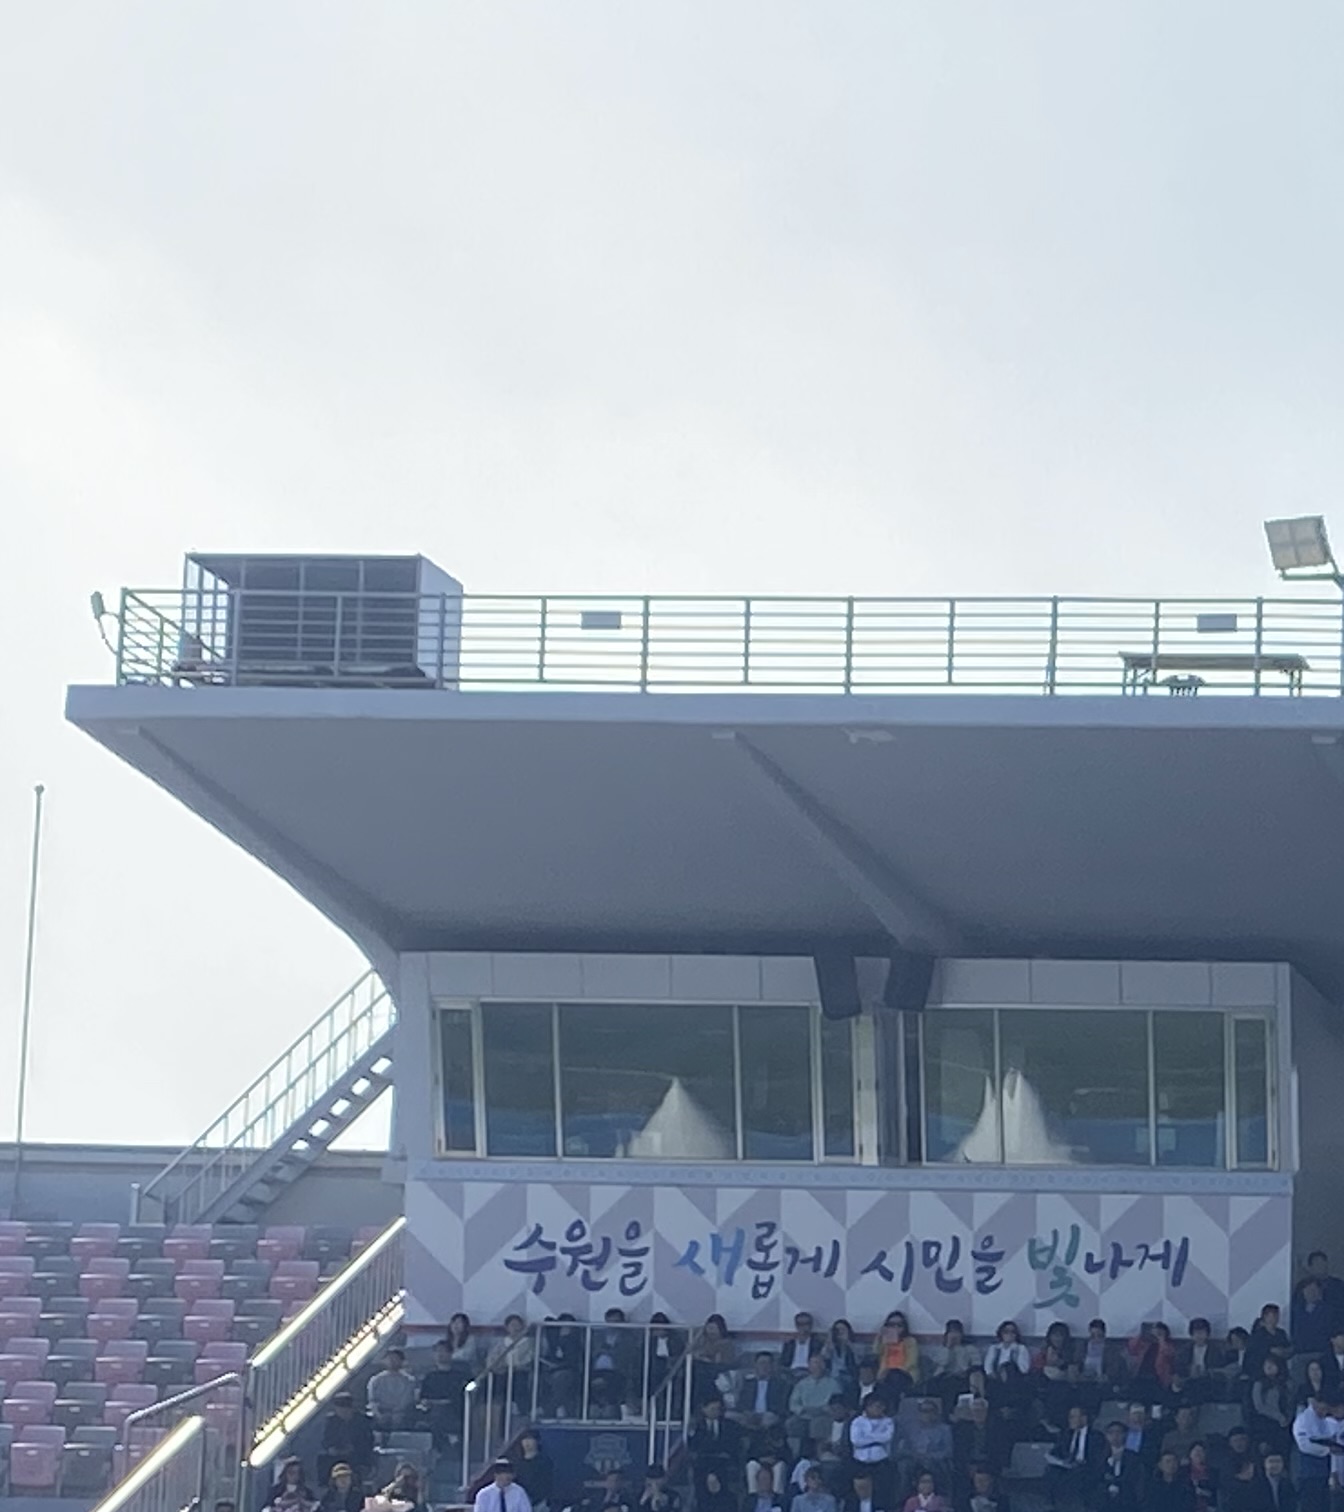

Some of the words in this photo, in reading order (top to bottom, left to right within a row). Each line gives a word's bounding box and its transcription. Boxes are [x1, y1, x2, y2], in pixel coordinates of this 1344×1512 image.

[503, 1218, 650, 1295] 수원을
[674, 1219, 841, 1300] 새롭게
[861, 1221, 1006, 1294] 시민을
[1026, 1223, 1192, 1310] 빛나게
